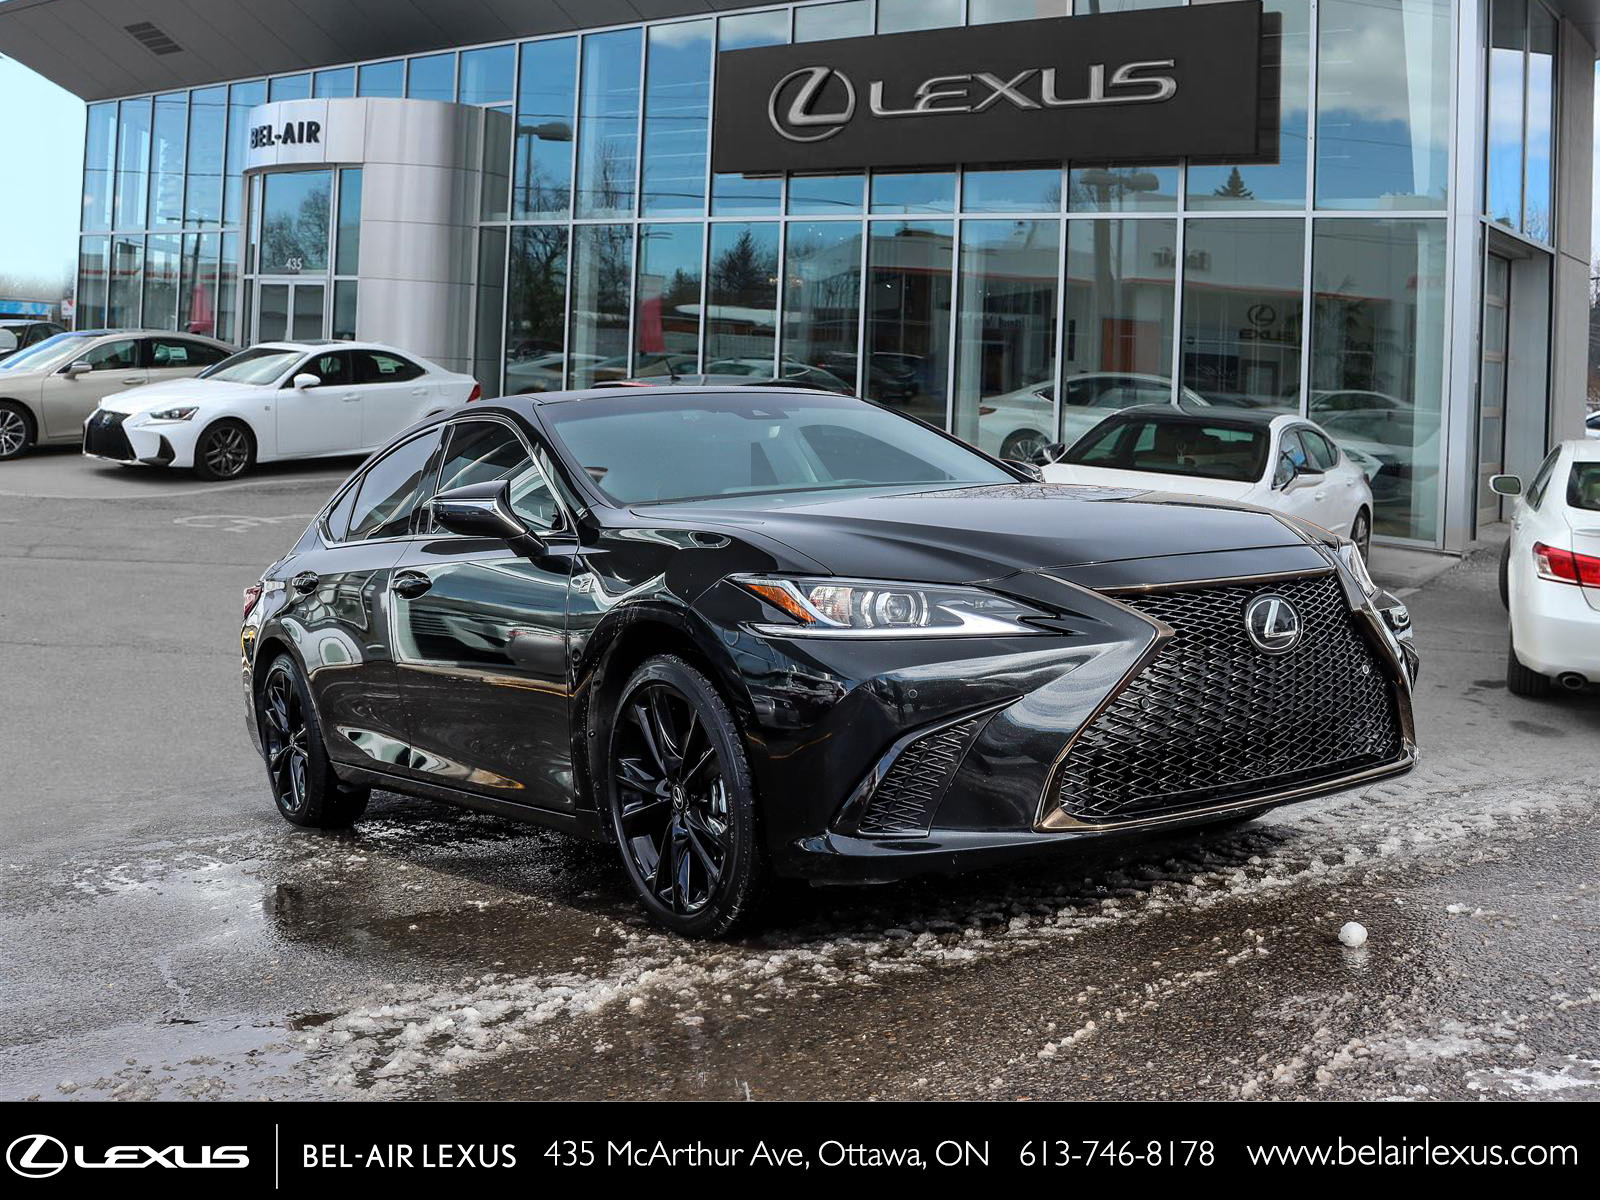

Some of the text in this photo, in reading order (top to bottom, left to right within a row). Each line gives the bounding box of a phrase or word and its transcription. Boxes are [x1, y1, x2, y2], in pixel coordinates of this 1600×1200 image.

[869, 59, 1178, 118] LEXUS
[250, 121, 321, 149] BEL-AIR
[286, 257, 302, 270] 435
